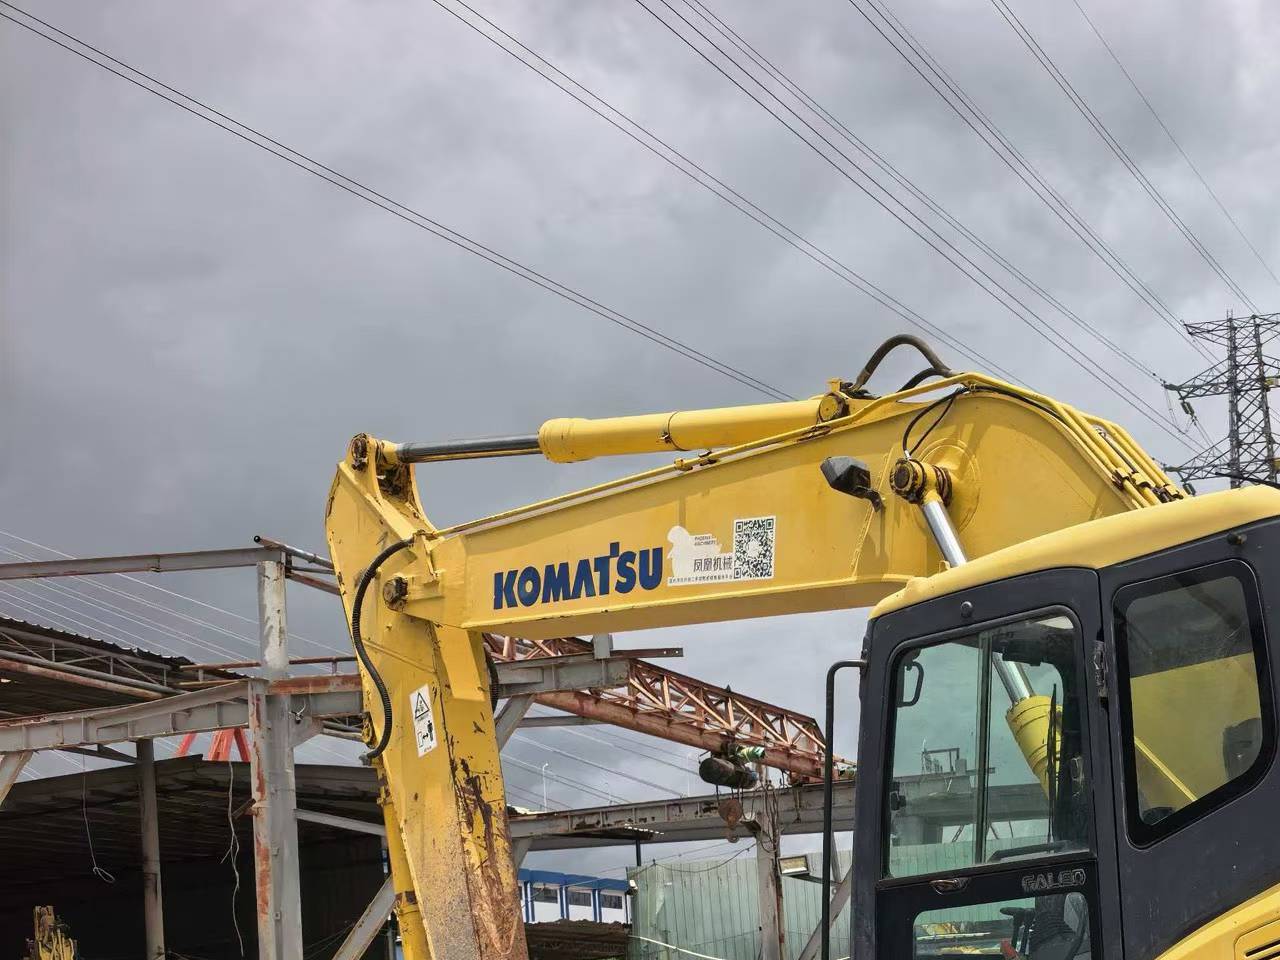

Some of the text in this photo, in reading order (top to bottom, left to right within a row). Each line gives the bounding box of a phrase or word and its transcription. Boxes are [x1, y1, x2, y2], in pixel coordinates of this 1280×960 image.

[493, 541, 664, 611] KOMATSU
[693, 556, 733, 572] 凤凰机械
